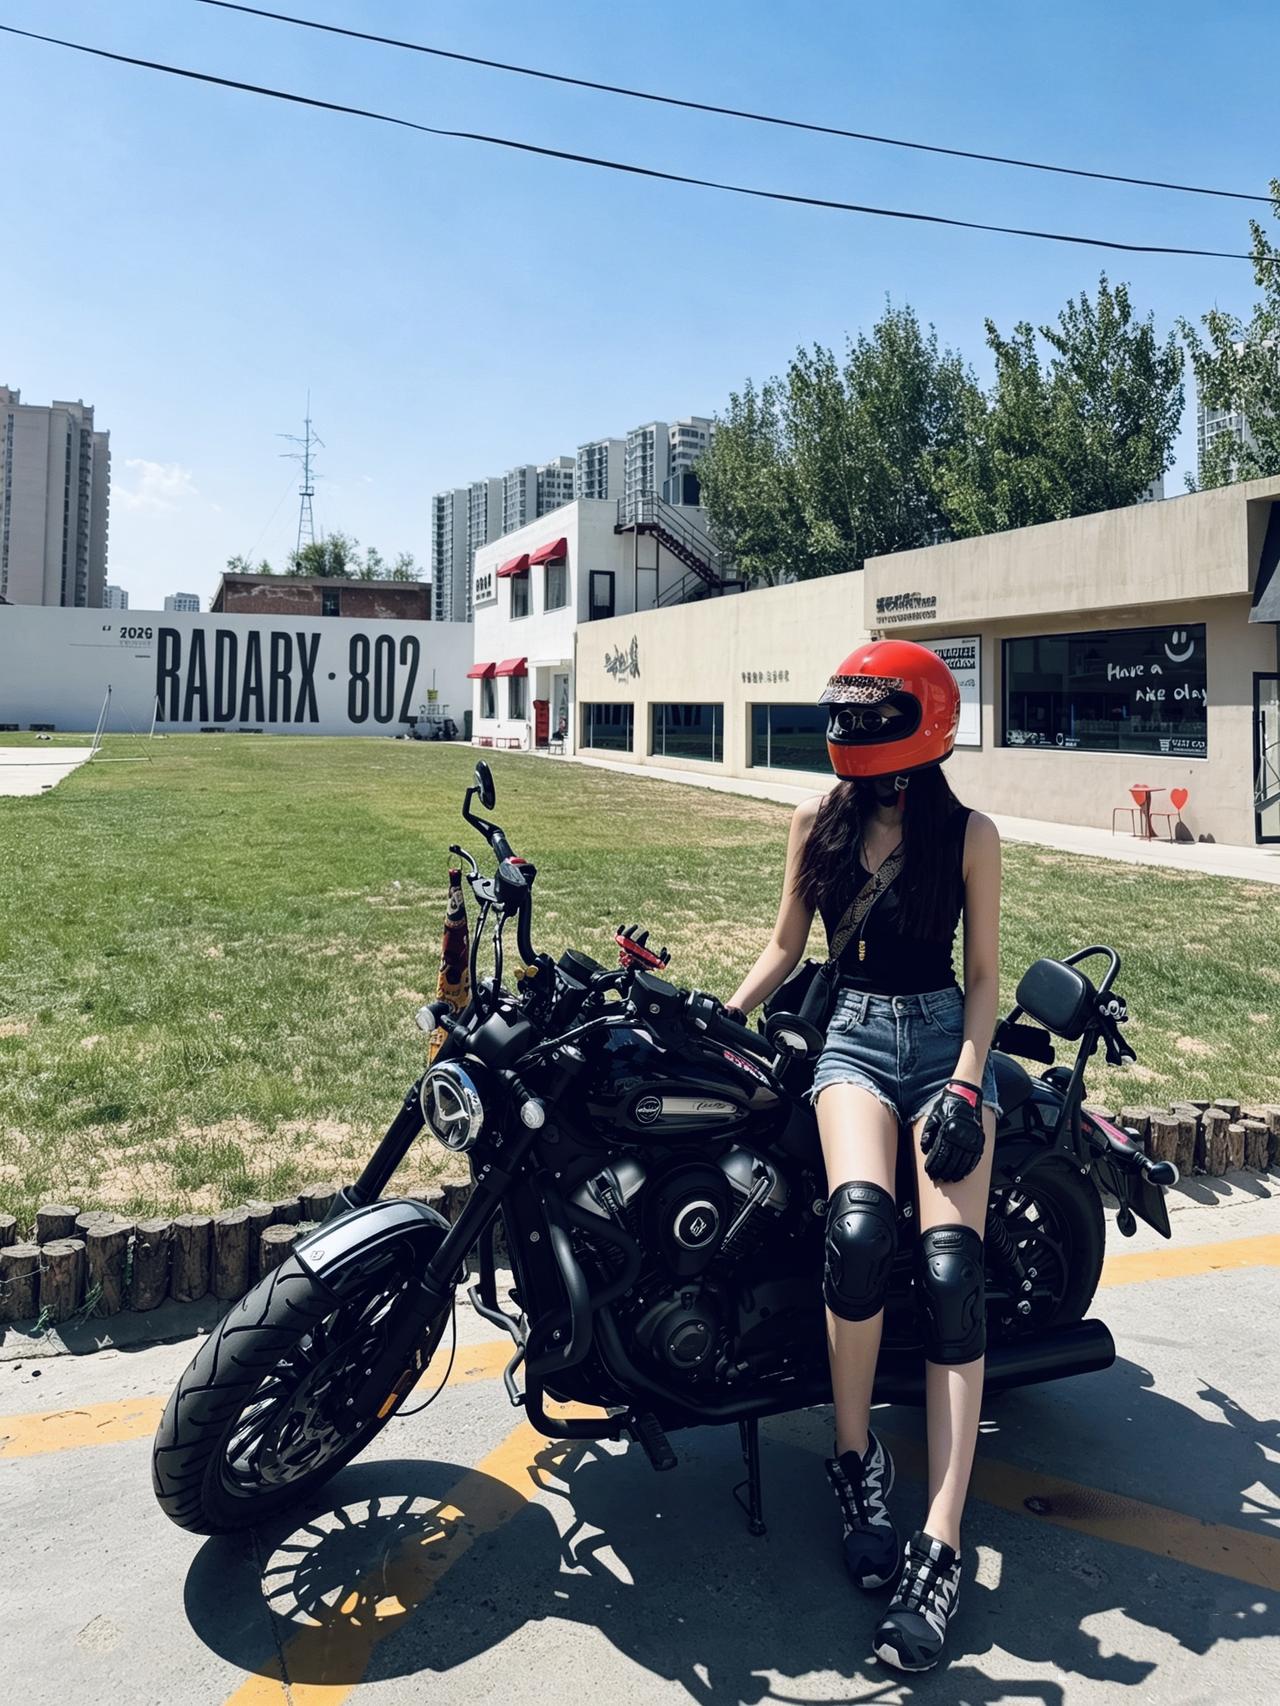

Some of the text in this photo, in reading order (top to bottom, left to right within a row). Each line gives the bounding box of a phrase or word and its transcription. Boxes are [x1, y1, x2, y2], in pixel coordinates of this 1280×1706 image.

[155, 627, 321, 722] RADARX
[348, 633, 420, 723] 802
[1107, 663, 1163, 681] Have a
[1136, 683, 1207, 707] nice day
